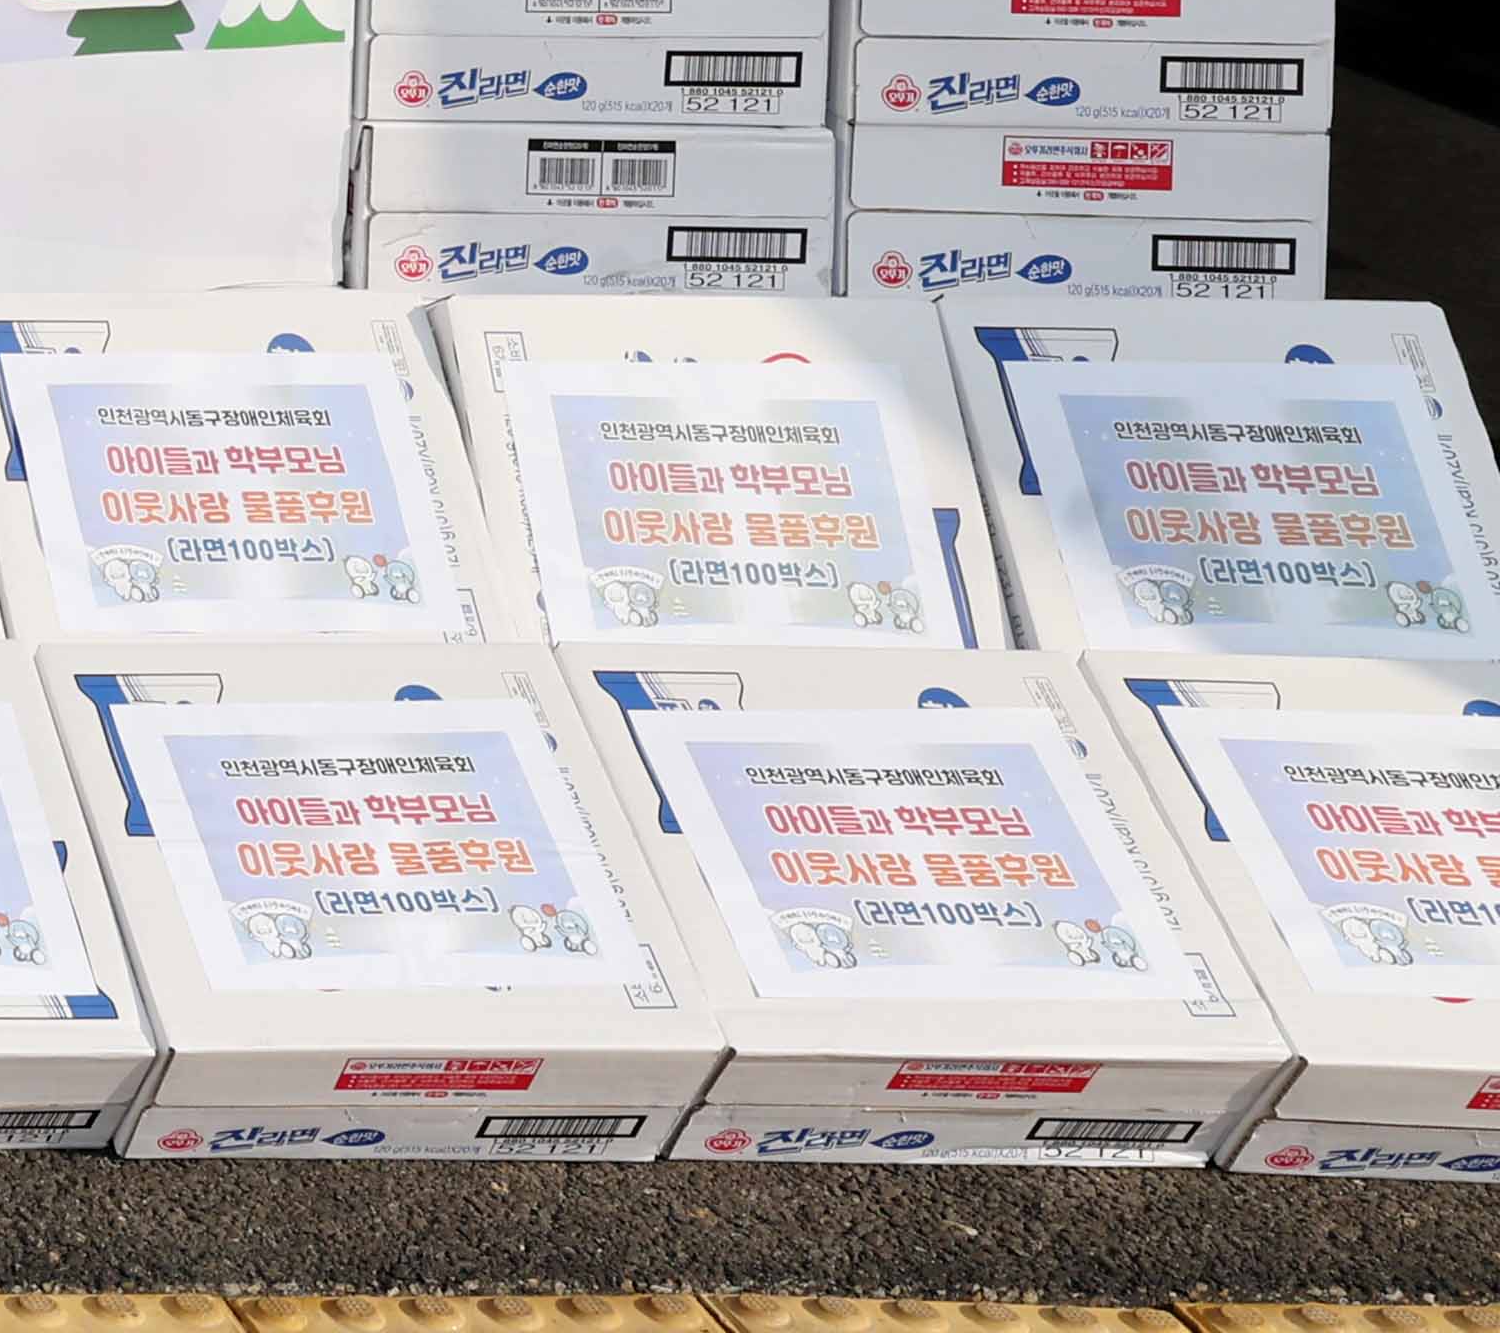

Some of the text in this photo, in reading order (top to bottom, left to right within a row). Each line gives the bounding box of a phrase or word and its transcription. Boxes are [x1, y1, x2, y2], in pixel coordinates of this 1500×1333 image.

[437, 68, 581, 109] 진라면 순한맛
[686, 97, 776, 112] 52 121
[918, 249, 1065, 291] 진라면 순한맛
[1175, 282, 1268, 298] 52 121
[98, 408, 331, 427] 인천광역시동구장애인체육회
[1114, 422, 1362, 444] 인천광역시동구장애인체육회
[107, 446, 345, 475] 아이들과 학부모님
[1124, 461, 1379, 498] 아이들과 학부모님
[103, 491, 373, 523] 이웃사랑 물품후원
[1122, 509, 1414, 550] 이웃사랑 물품후원
[745, 768, 1004, 786] 인천광역시동구장애인체육회
[765, 805, 1031, 836] 아이들과 학부모님
[771, 852, 1076, 887] 이웃사랑 물품후원
